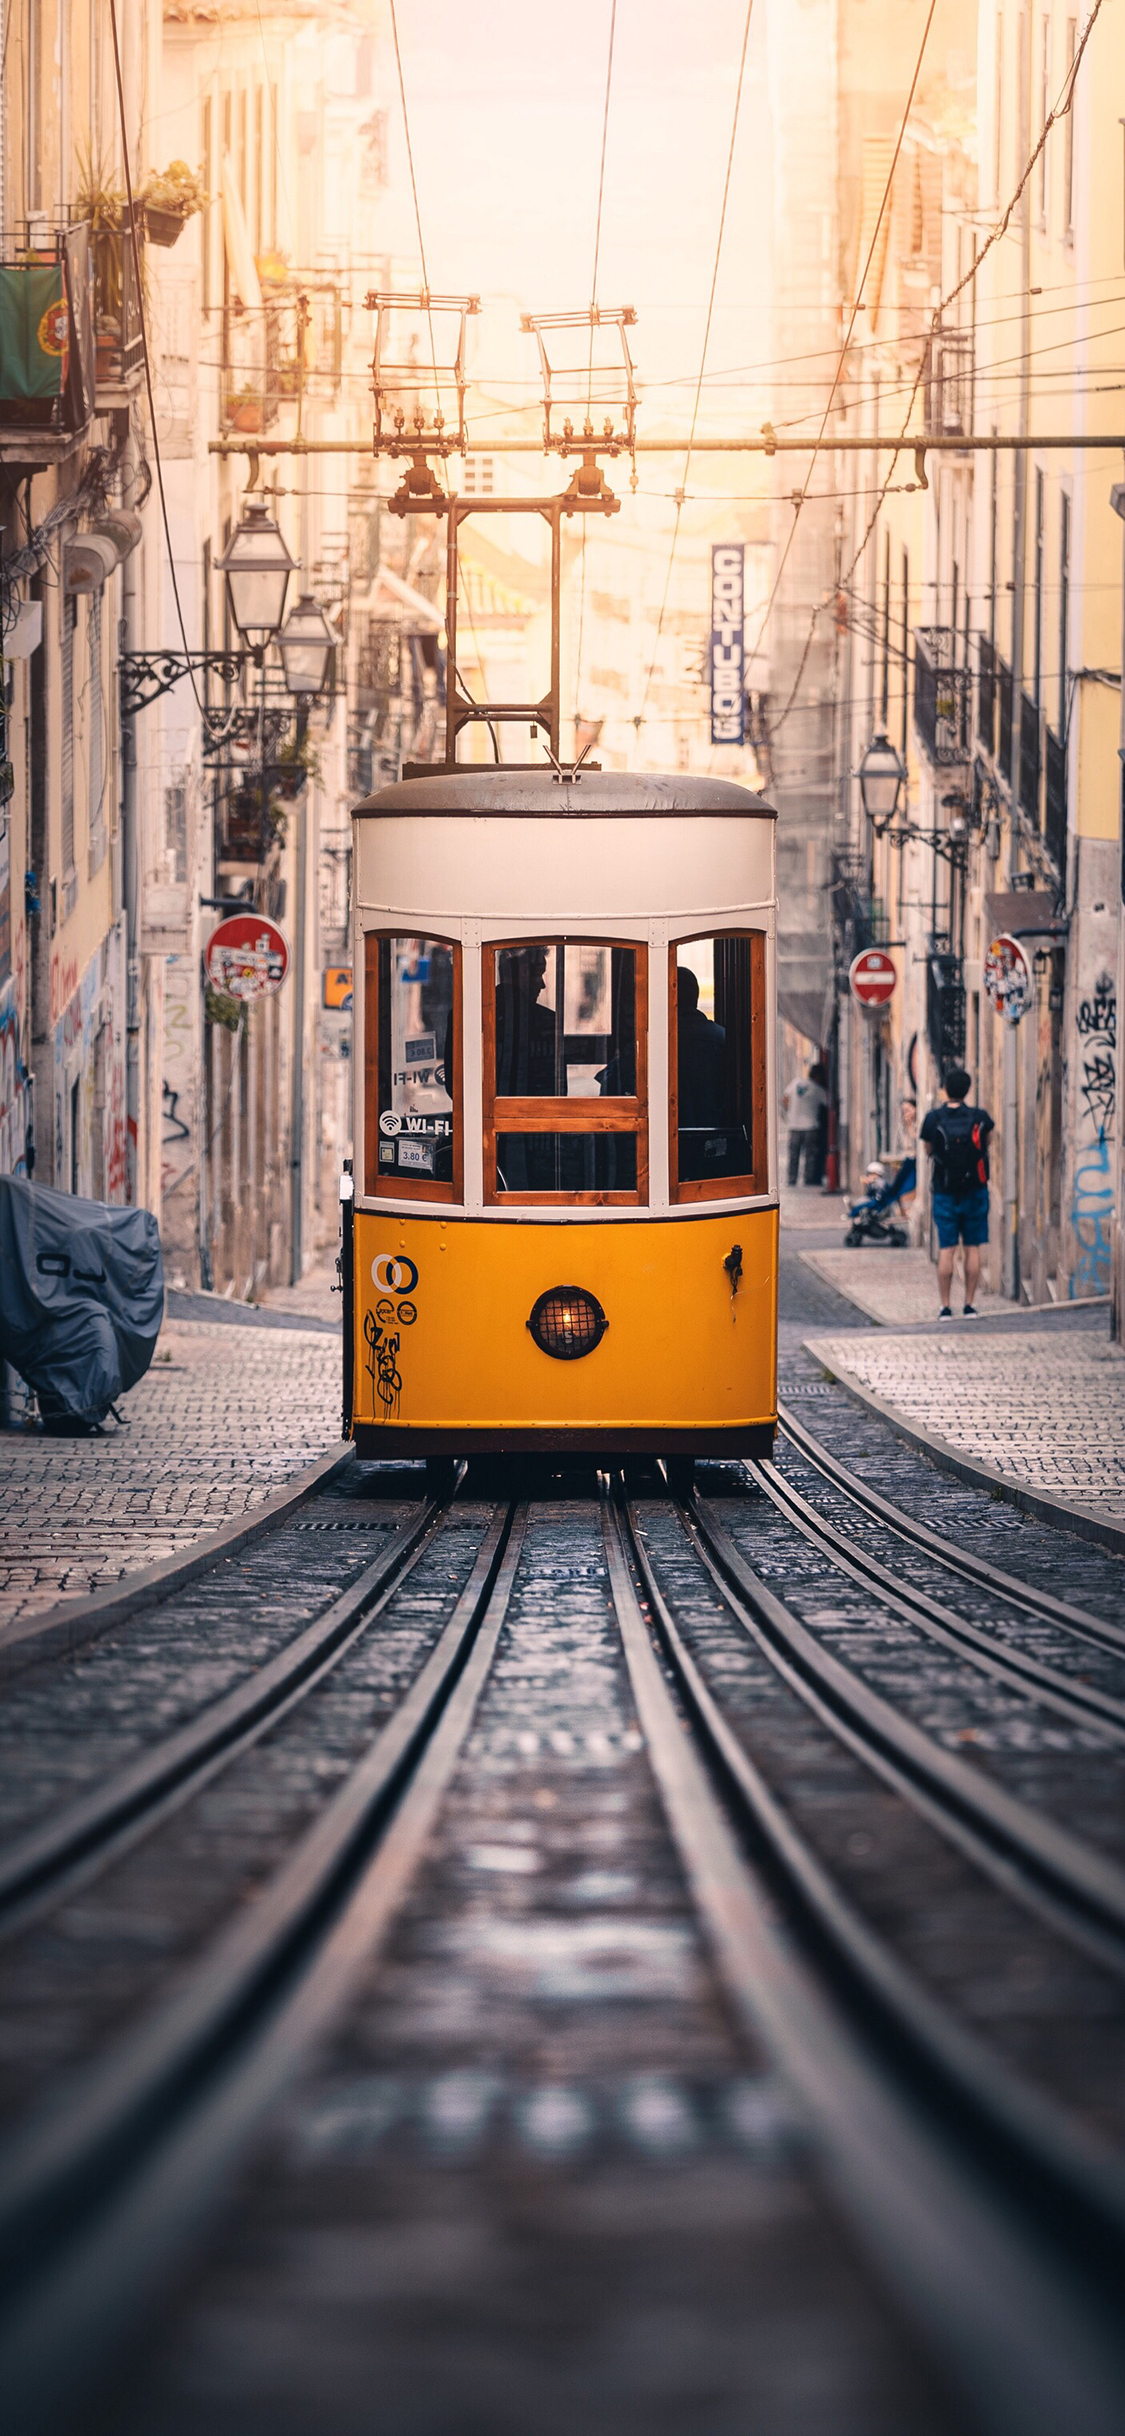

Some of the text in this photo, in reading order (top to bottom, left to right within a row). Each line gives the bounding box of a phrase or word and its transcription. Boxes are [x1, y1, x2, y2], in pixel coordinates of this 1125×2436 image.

[713, 549, 742, 739] CONTUBOS
[406, 1117, 449, 1136] WI-FI
[403, 1151, 428, 1162] 3.80 €
